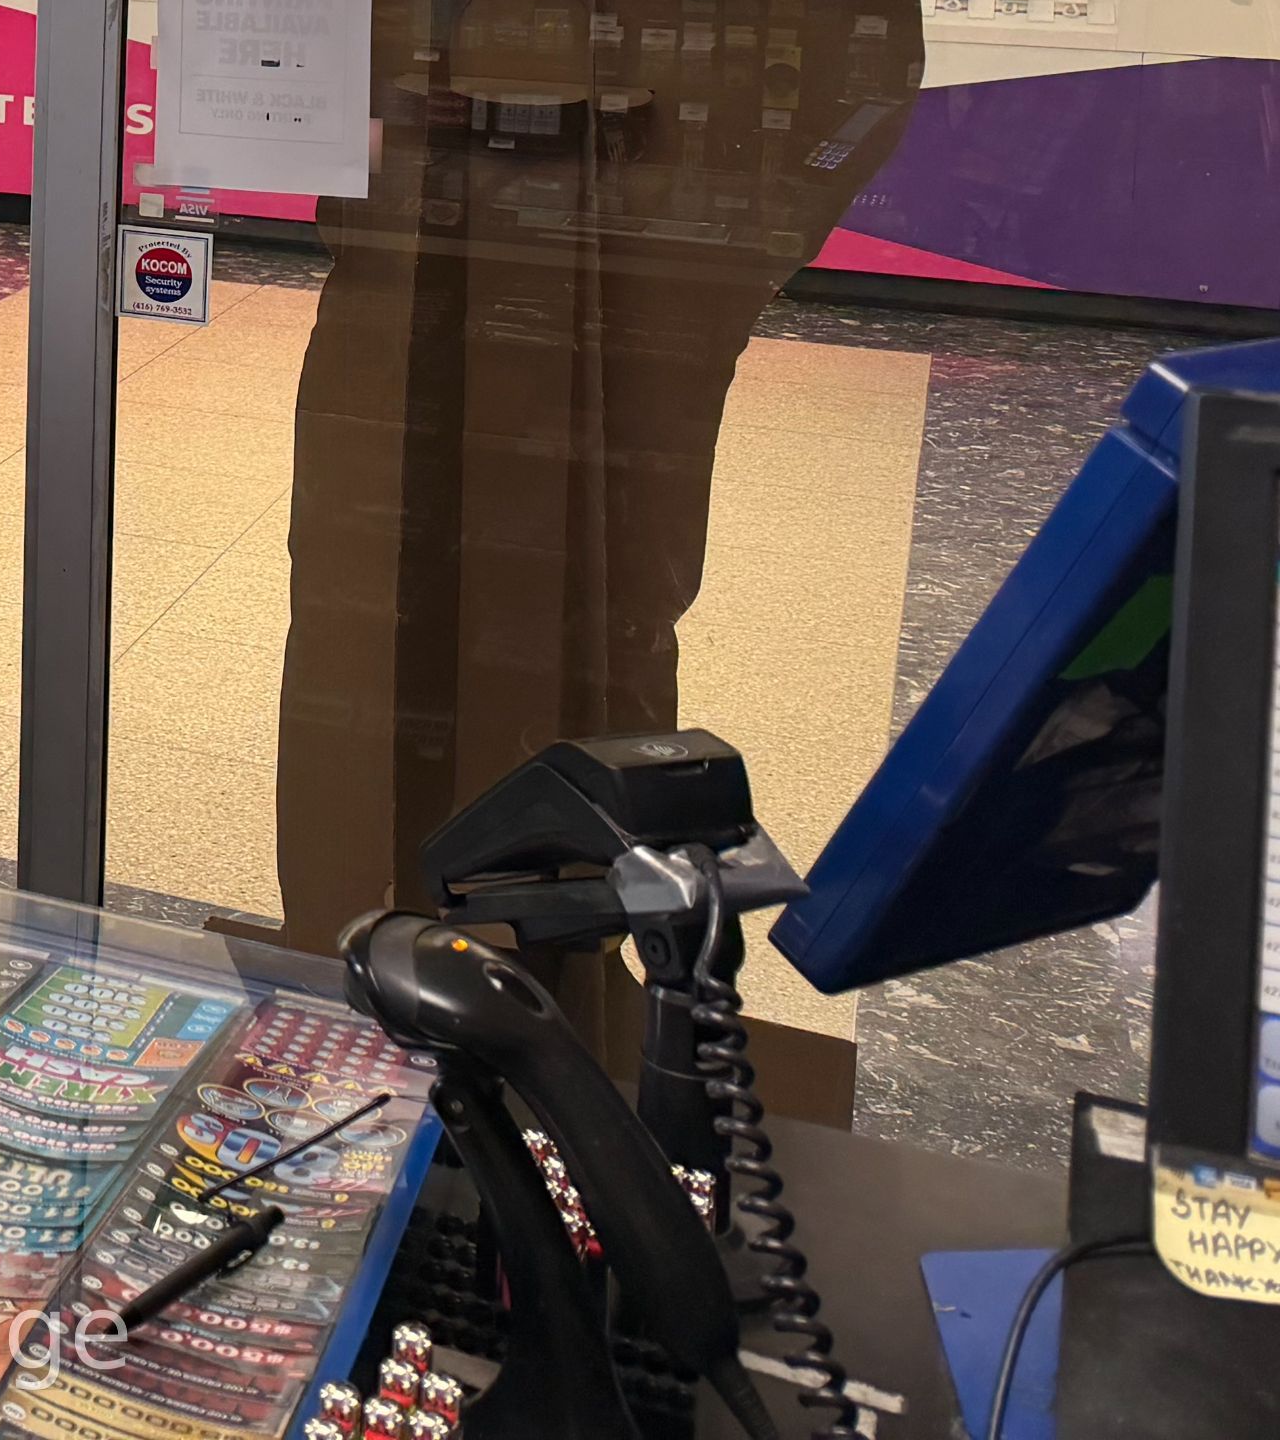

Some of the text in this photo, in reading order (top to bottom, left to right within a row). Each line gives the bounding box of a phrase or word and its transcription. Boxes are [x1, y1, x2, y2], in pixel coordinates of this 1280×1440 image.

[141, 258, 188, 275] KOCOM
[145, 275, 183, 288] Security
[145, 285, 182, 297] systems
[132, 301, 154, 312] (416)
[1170, 1187, 1252, 1230] STAY
